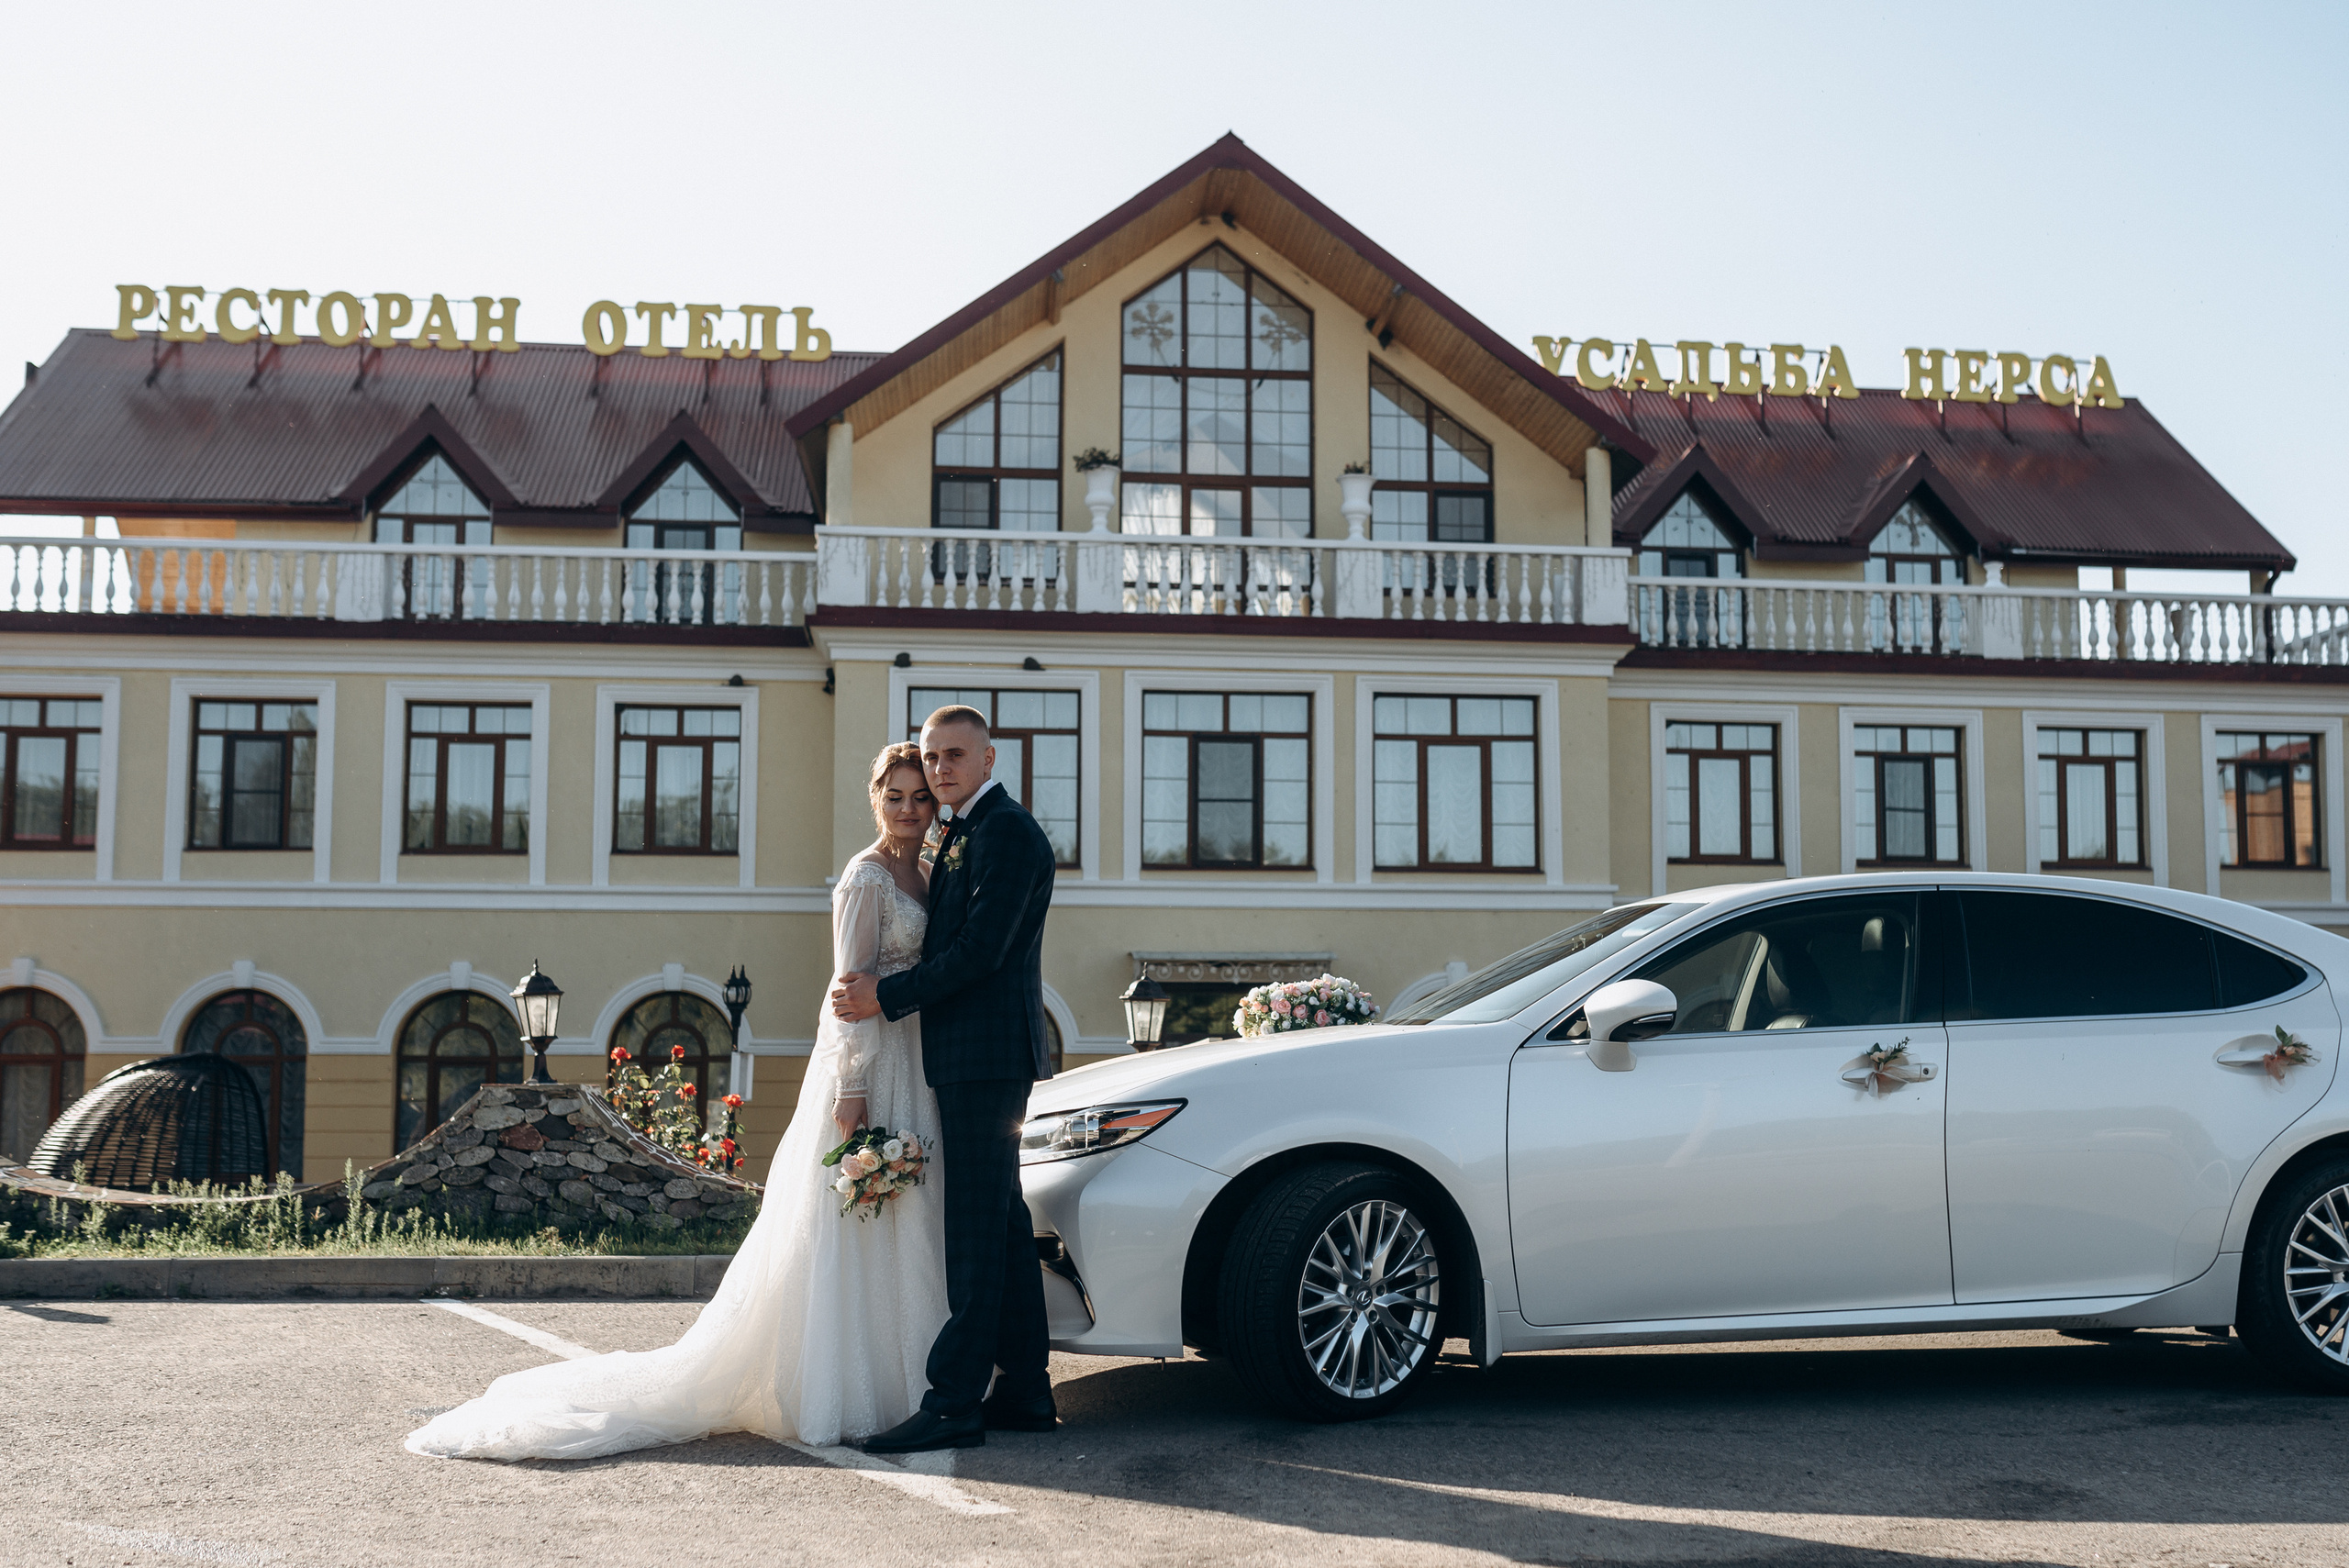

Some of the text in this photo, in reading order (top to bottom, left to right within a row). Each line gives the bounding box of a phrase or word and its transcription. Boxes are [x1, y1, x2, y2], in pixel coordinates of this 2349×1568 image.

[110, 284, 832, 362] РЕСТОРАН ОТЕЛЬ
[1531, 335, 2125, 409] УСАДЬБА НЕРСА
